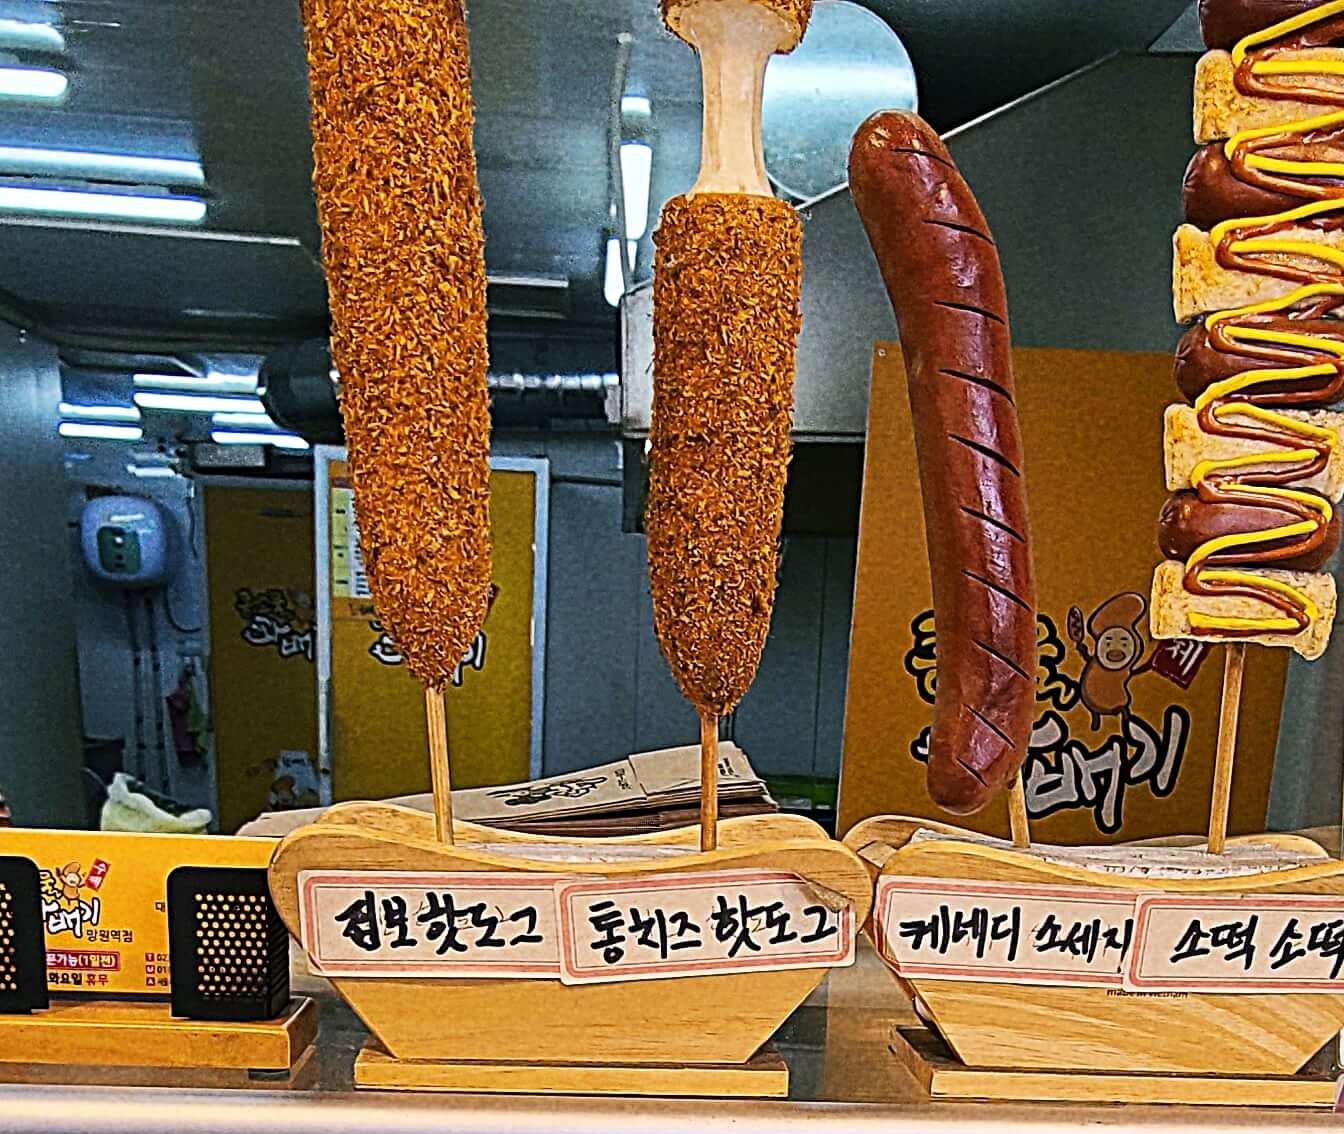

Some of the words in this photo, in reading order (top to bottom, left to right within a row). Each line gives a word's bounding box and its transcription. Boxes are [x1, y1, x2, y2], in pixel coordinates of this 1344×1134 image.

[711, 894, 840, 957] 핫도그
[899, 905, 1020, 962] 케네디
[1169, 914, 1257, 971] 소떡
